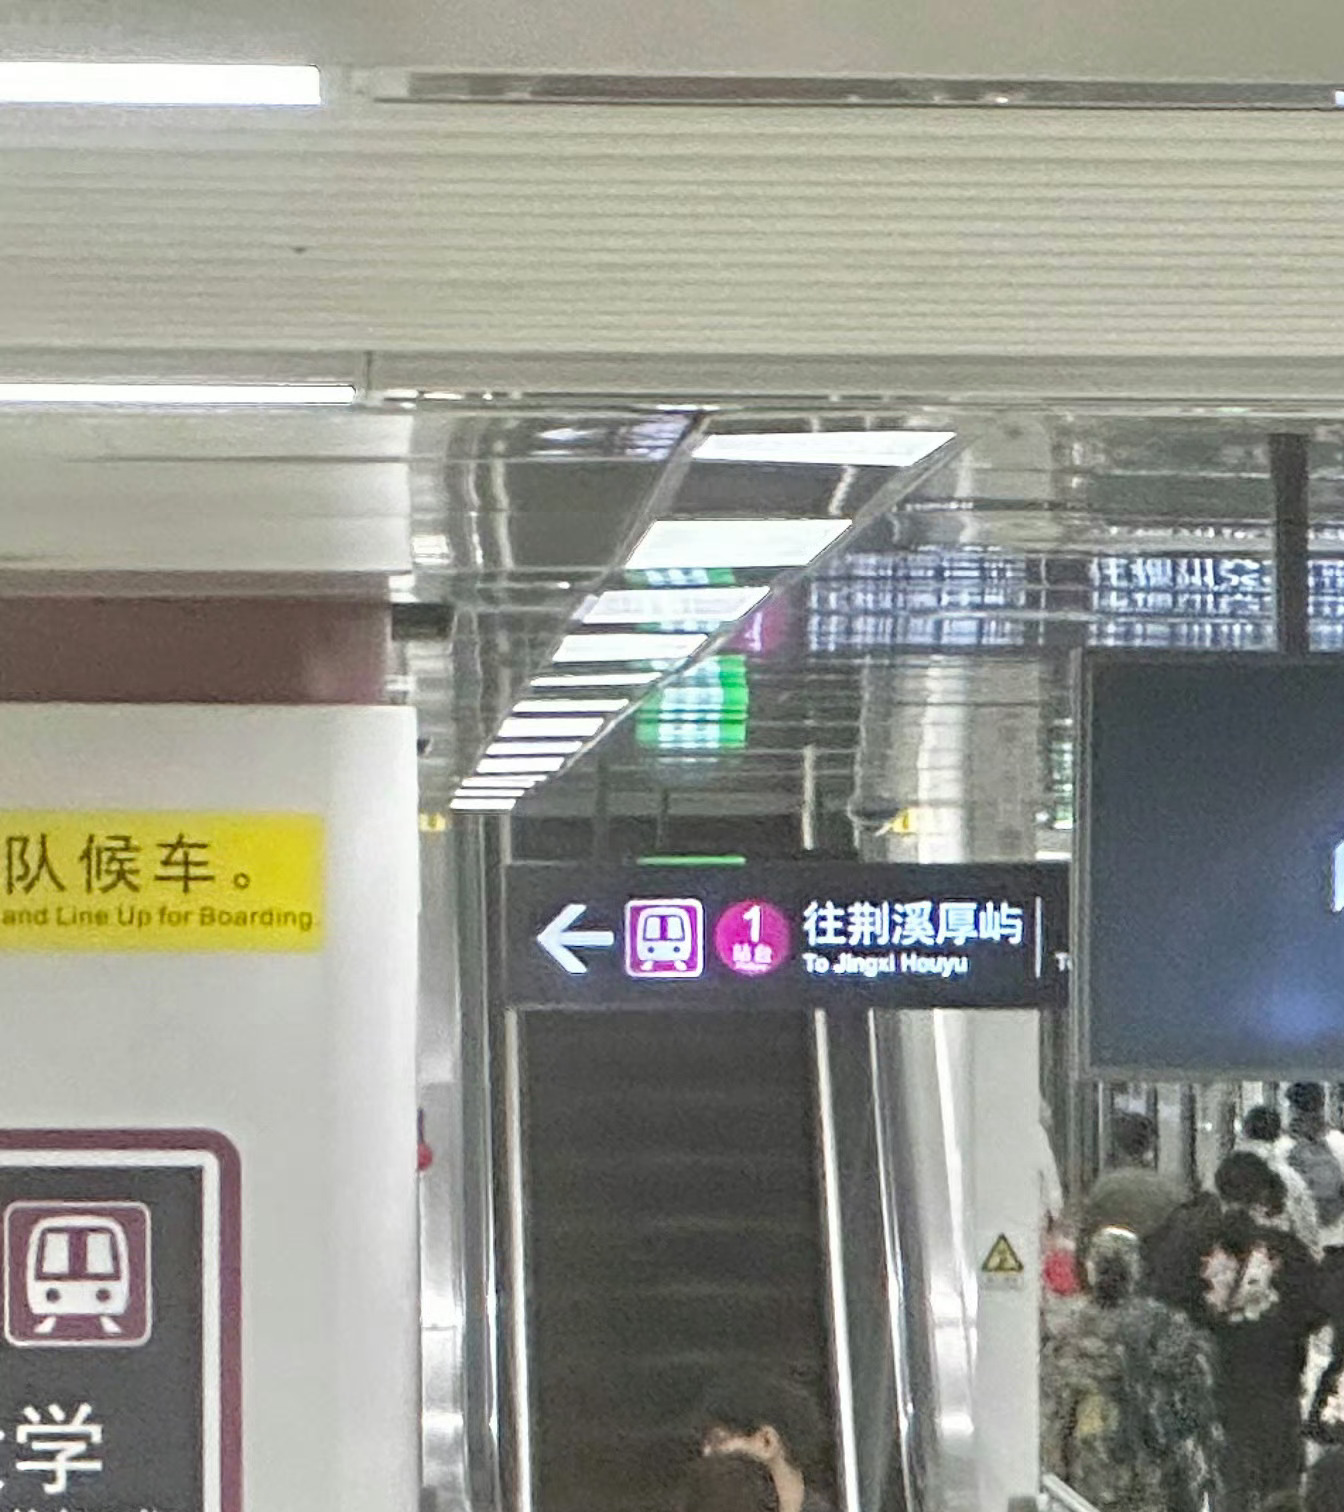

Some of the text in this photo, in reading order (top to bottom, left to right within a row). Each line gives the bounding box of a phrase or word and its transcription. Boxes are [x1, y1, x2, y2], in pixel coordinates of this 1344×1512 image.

[5, 833, 250, 895] 队候车。
[2, 906, 49, 926] and
[56, 906, 109, 926] Line
[117, 906, 151, 929] Up
[158, 905, 192, 926] for
[742, 900, 1024, 946] 1 往荆溪厚屿
[802, 952, 830, 973] To
[901, 952, 969, 978] Houyu
